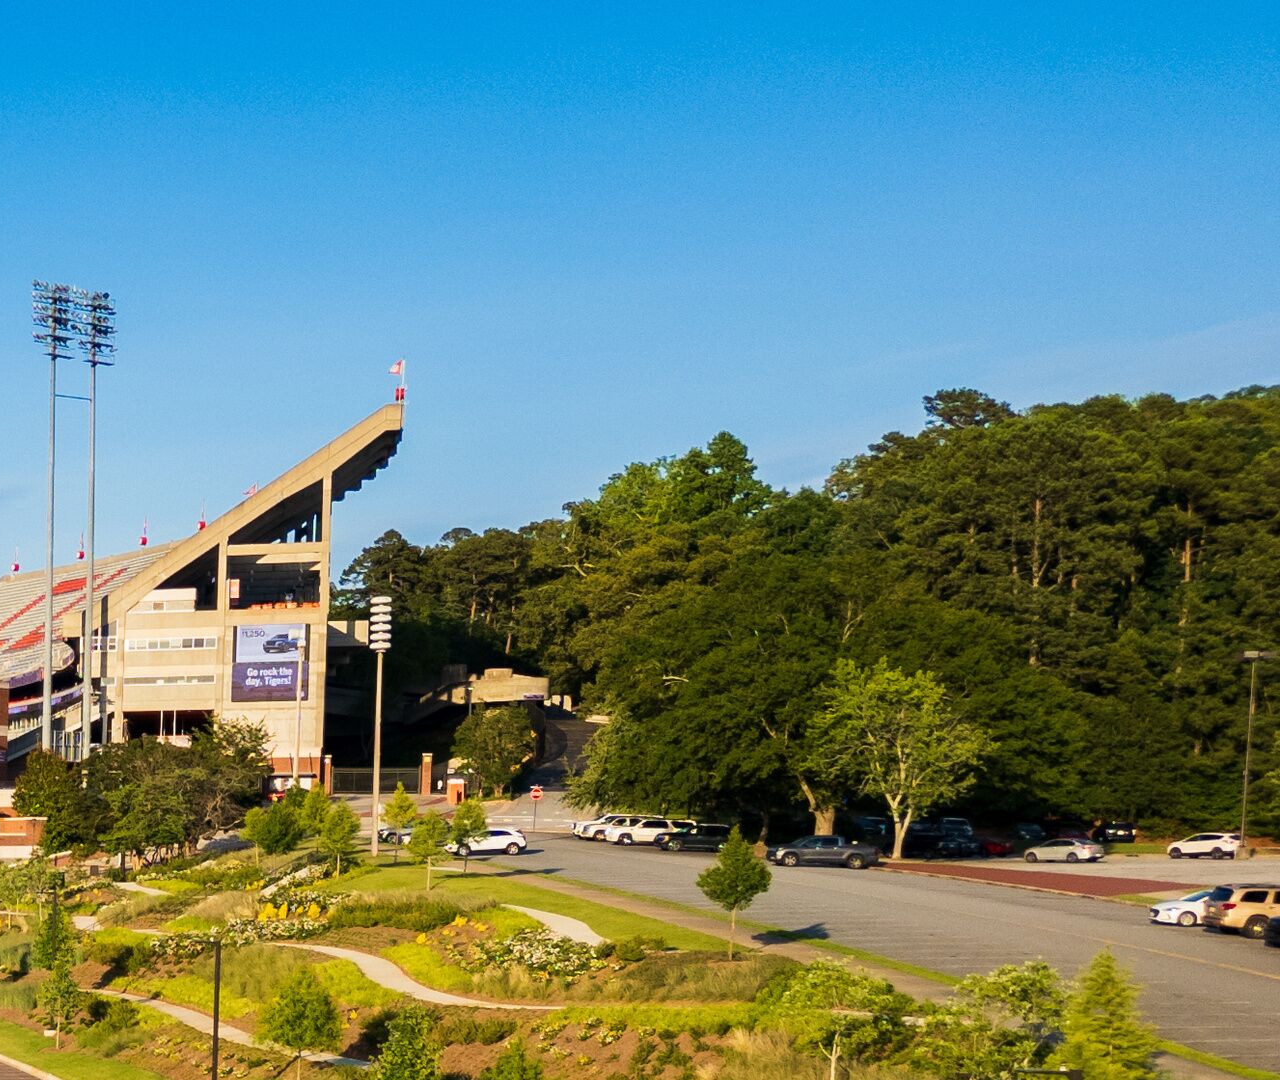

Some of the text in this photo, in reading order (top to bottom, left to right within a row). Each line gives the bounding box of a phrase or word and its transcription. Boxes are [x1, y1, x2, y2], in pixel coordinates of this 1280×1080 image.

[247, 667, 292, 676] Go rock the
[264, 676, 292, 686] Tigers!
